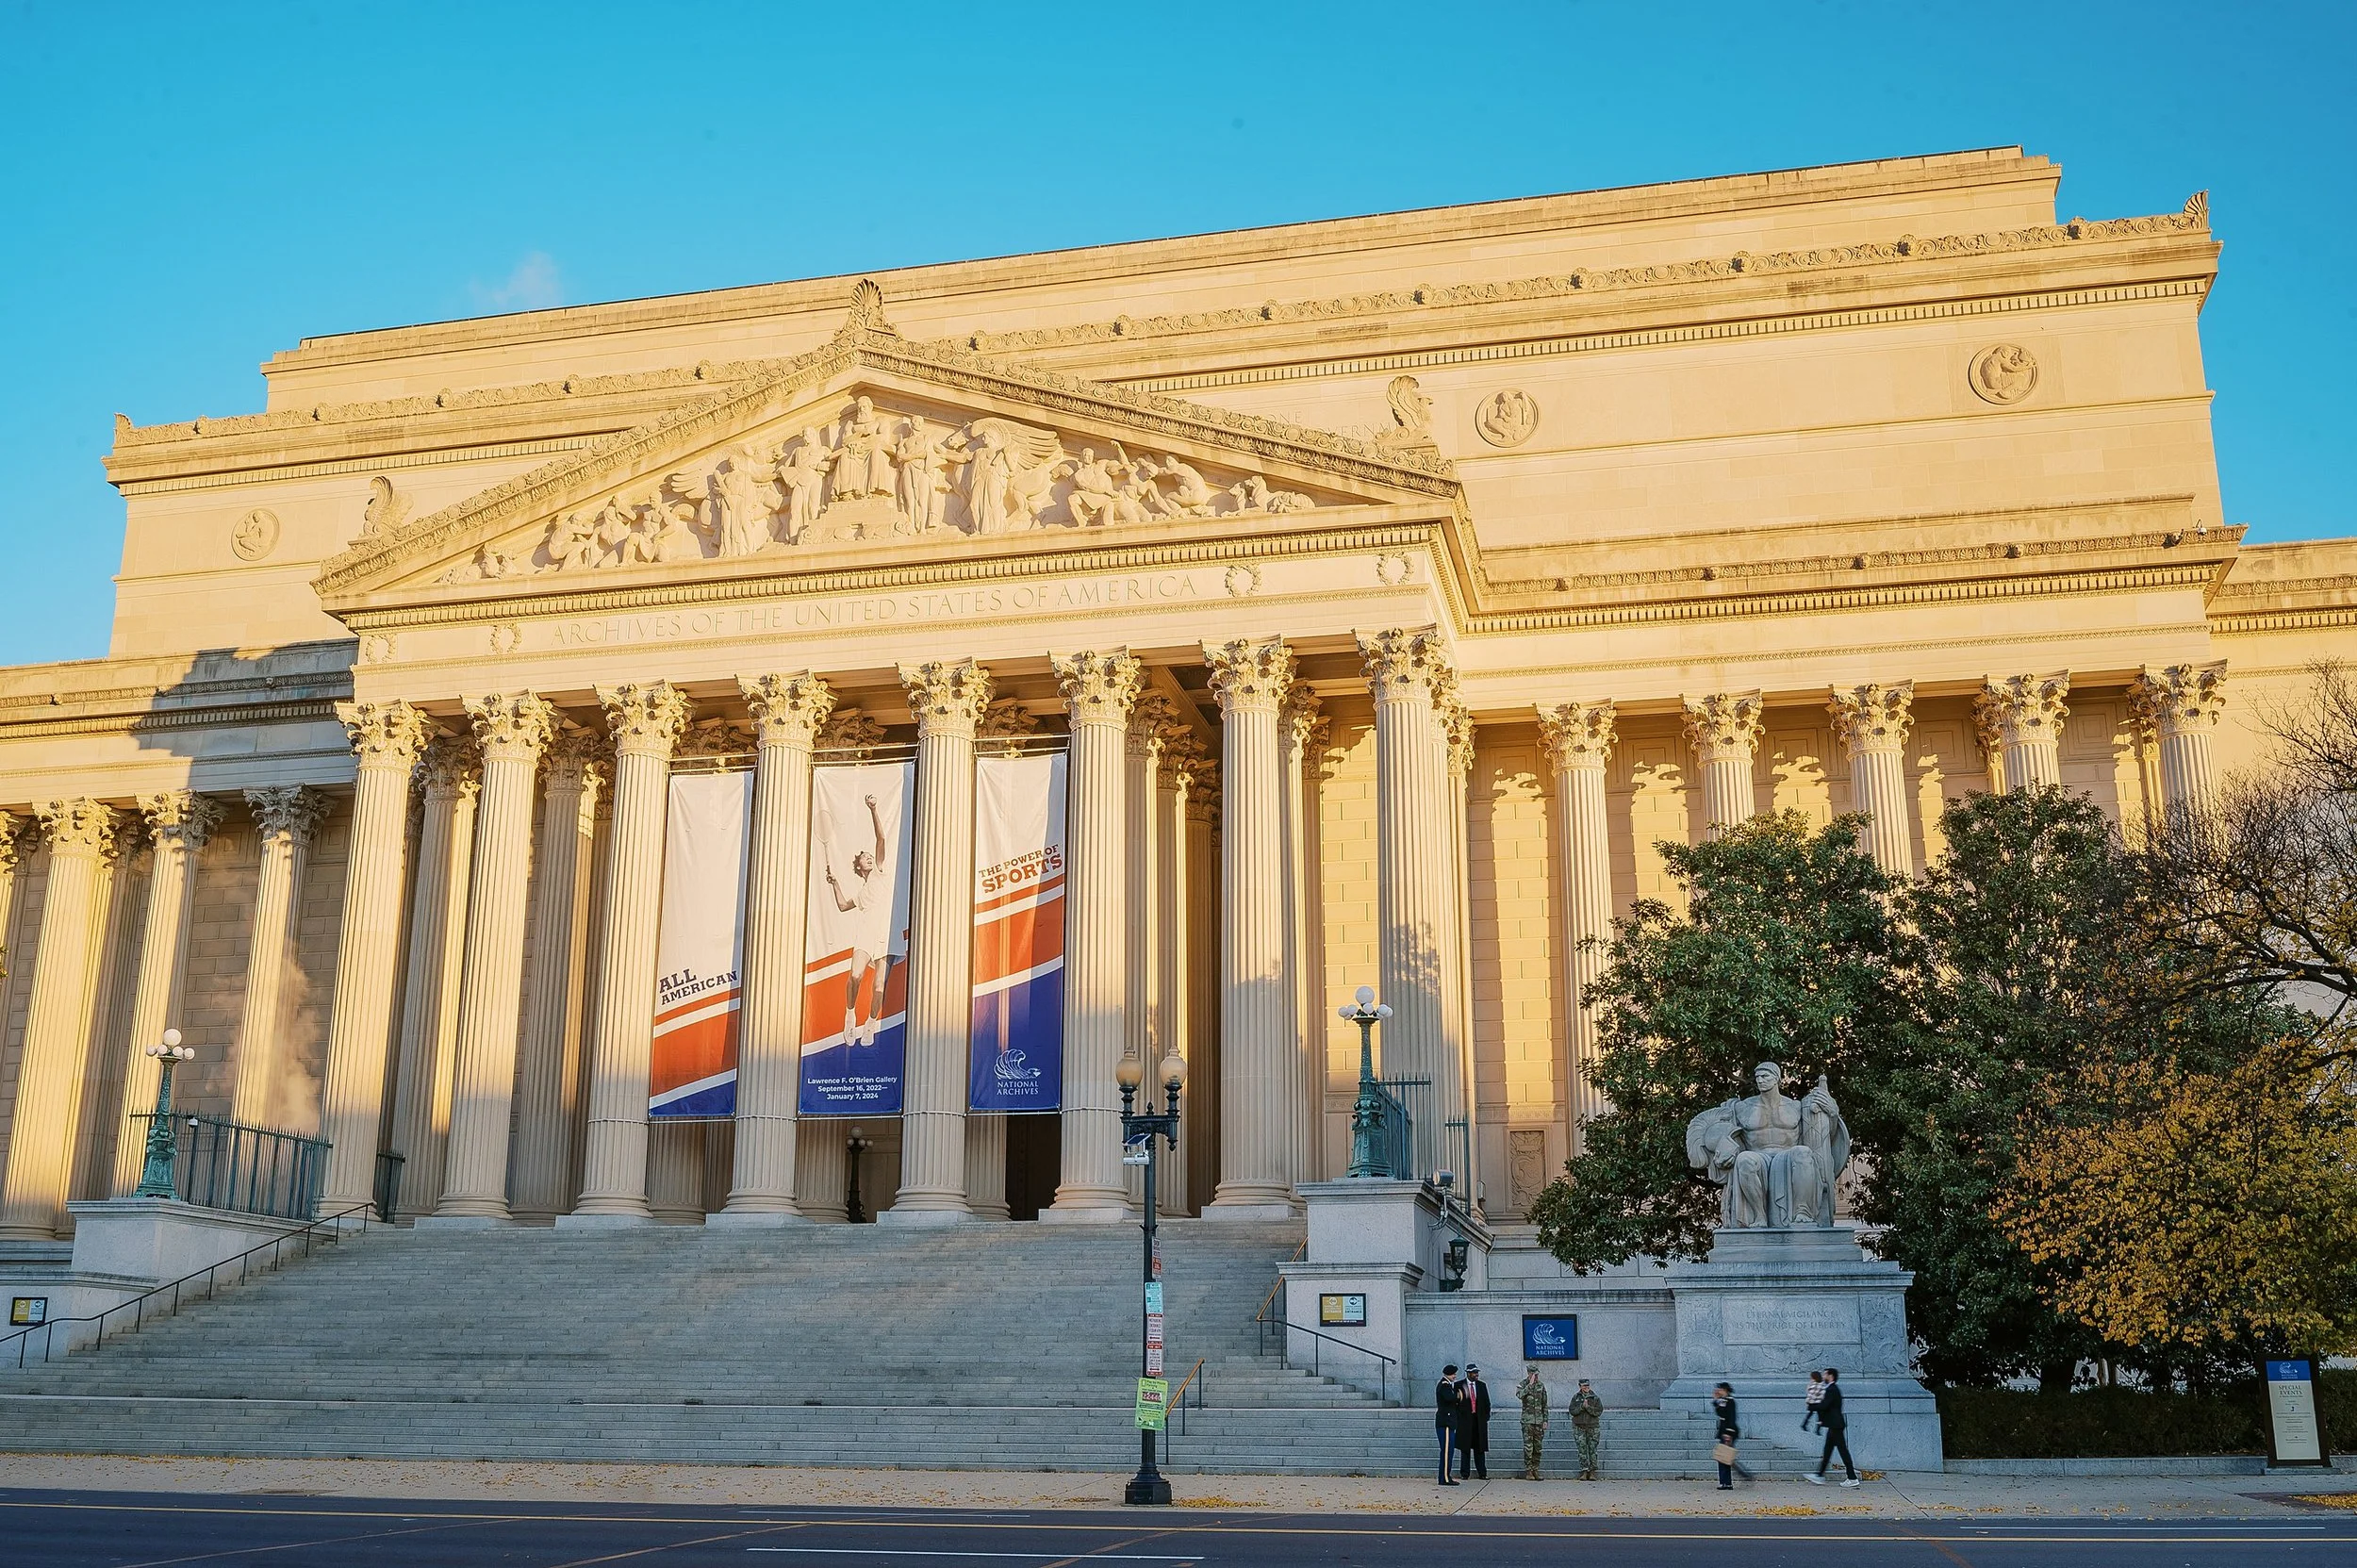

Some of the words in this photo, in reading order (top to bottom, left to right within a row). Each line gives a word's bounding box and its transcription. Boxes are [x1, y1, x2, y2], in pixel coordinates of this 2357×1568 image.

[551, 615, 681, 646] ARCHIVES
[691, 611, 725, 634] OF
[732, 607, 783, 632] THE
[795, 599, 897, 626] UNITED
[907, 590, 1002, 619] STATES
[1013, 586, 1047, 609] OF
[1057, 574, 1197, 606] AMERICA
[979, 865, 1002, 878] THE
[1003, 850, 1044, 870] POWER
[1045, 844, 1059, 856] OF
[981, 853, 1063, 894] SPORTS
[659, 968, 698, 994] ALL
[661, 970, 738, 1006] AMERICAN
[817, 1085, 854, 1094] September
[856, 1084, 865, 1093] 16,
[826, 1093, 854, 1101] January
